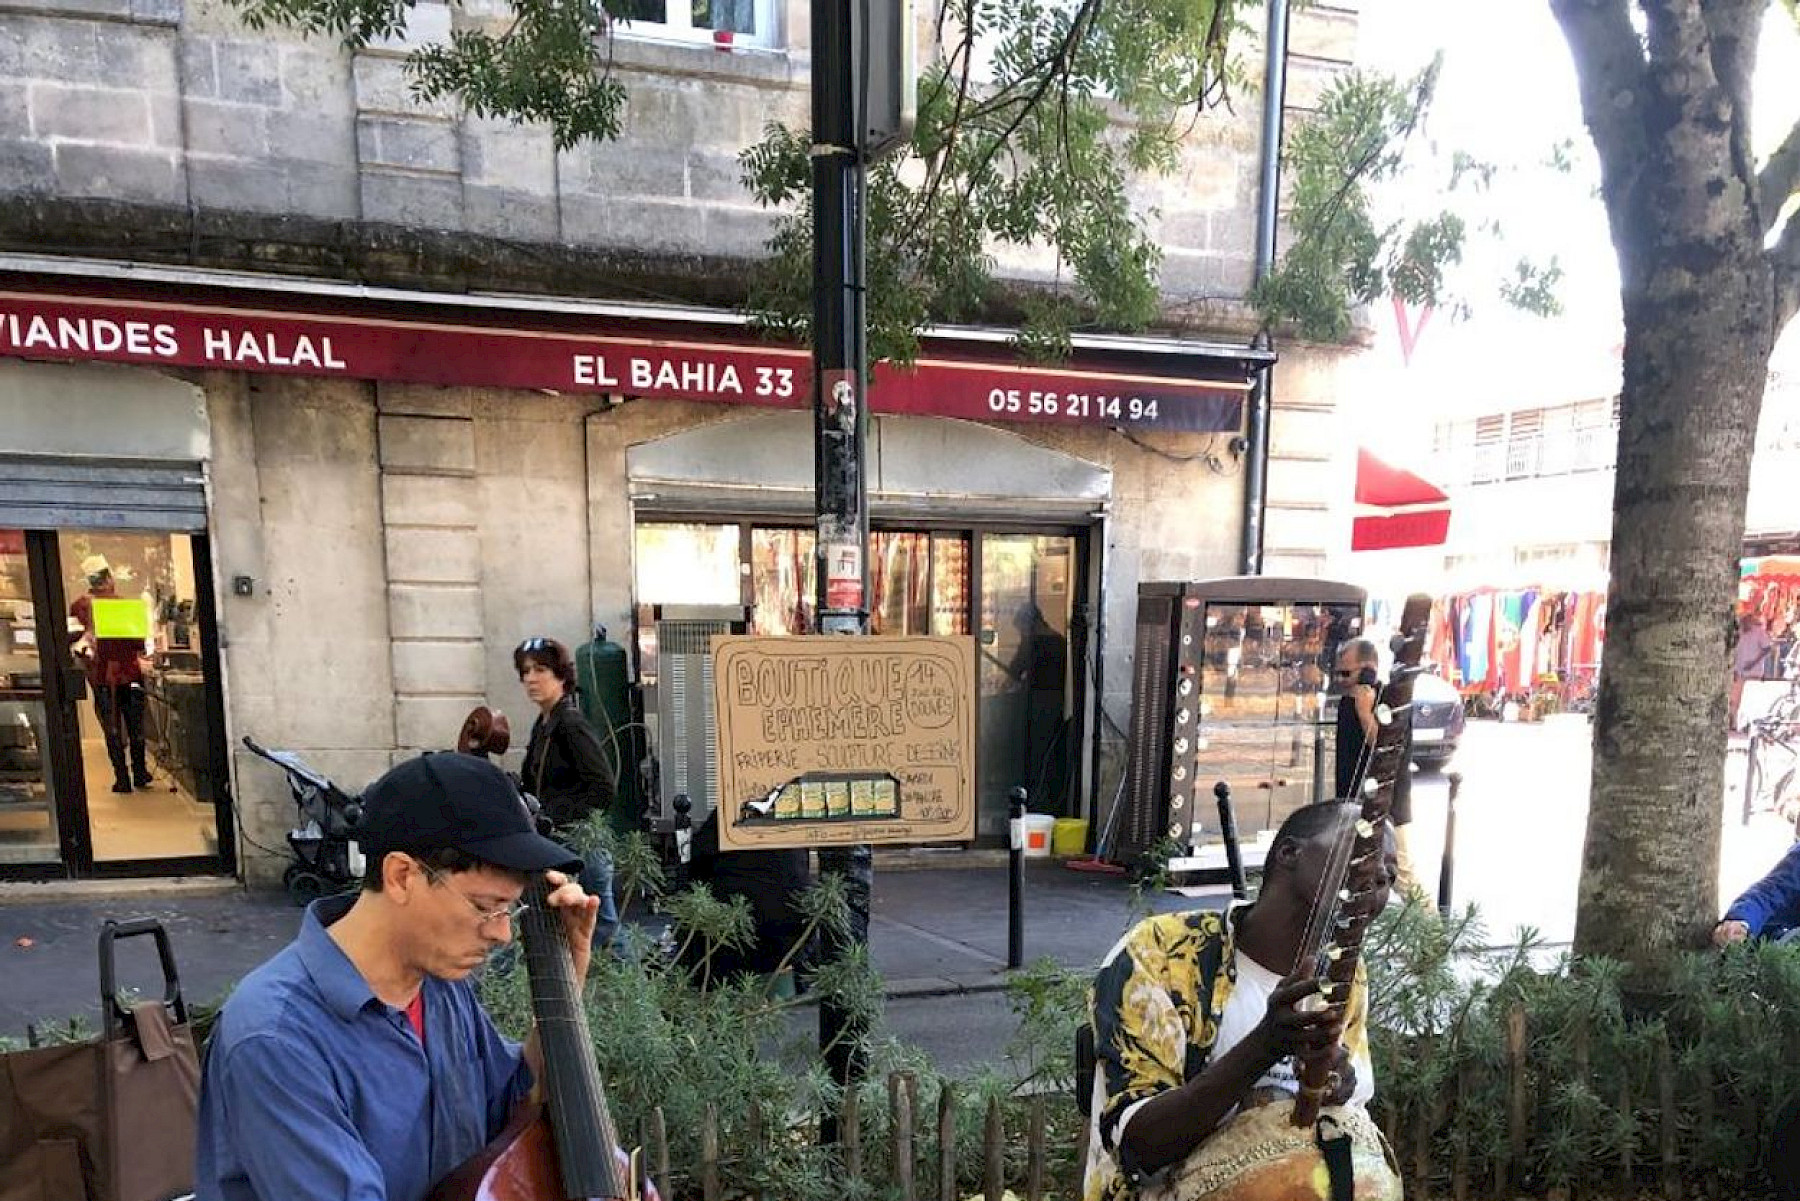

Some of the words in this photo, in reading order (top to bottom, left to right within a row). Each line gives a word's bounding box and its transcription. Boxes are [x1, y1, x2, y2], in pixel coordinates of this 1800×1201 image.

[0, 313, 179, 355] IANDES
[203, 328, 347, 369] HALAL
[574, 355, 618, 386] EL
[630, 358, 743, 395] BAHIA
[755, 366, 794, 397] 33
[988, 389, 1021, 413] 05
[1028, 390, 1058, 416] 56
[1065, 392, 1090, 417] 21
[1095, 394, 1122, 419] 14
[1129, 396, 1158, 421] 94
[910, 664, 937, 685] 14
[762, 703, 906, 743] EPHEMERE
[817, 743, 895, 768] SCULPTURE
